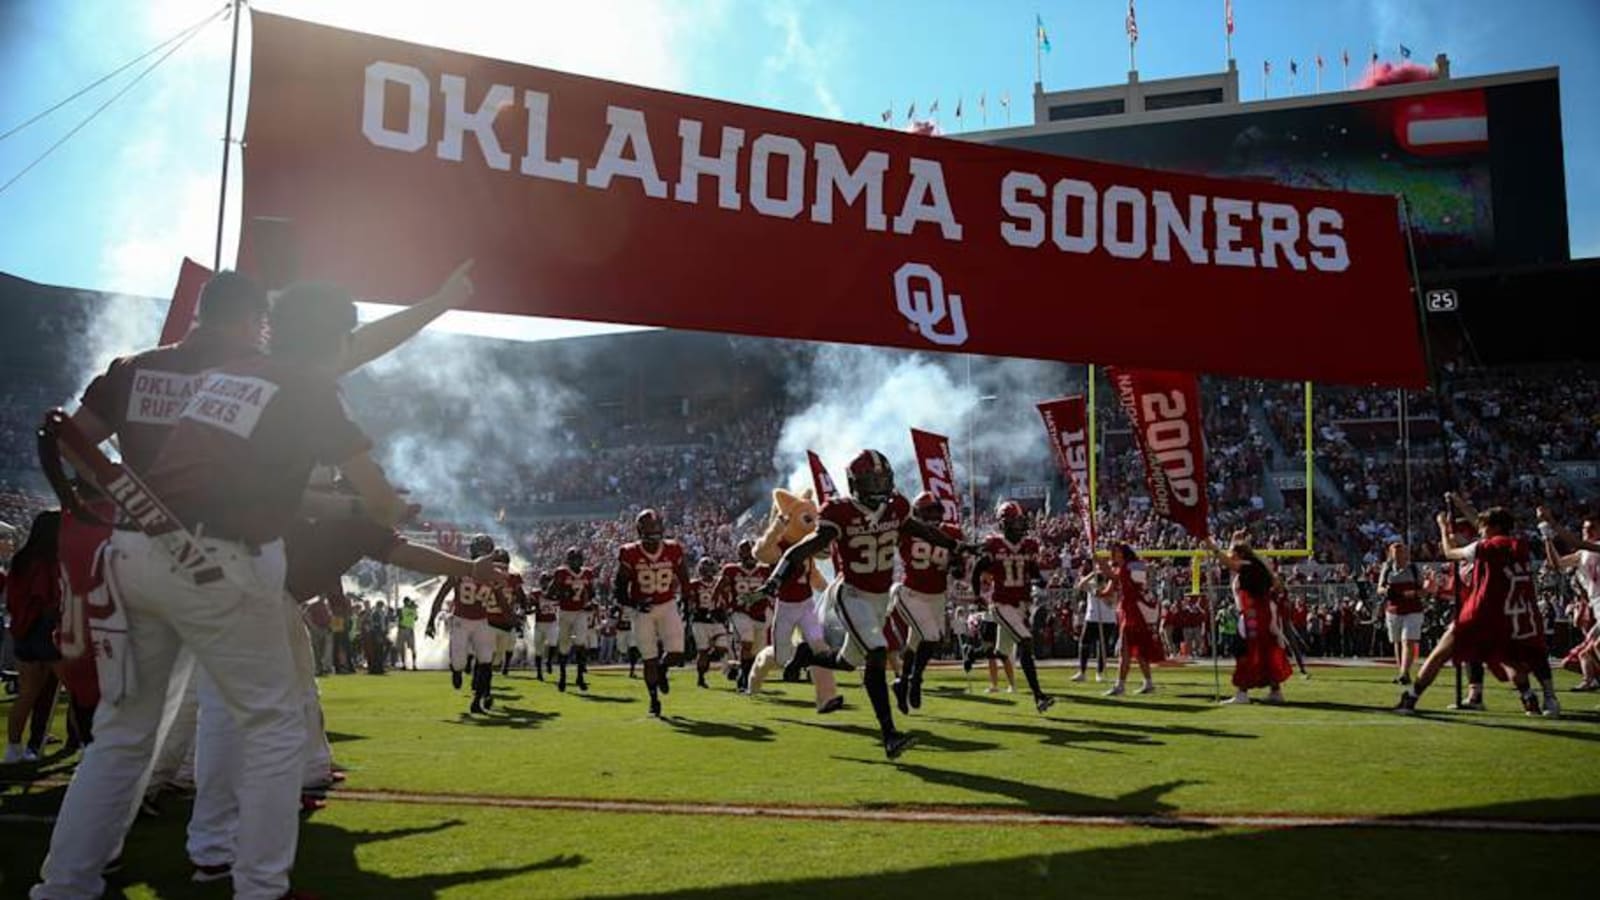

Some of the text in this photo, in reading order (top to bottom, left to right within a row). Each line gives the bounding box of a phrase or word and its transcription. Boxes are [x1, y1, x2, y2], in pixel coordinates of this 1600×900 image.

[362, 61, 1350, 272] OKLAHOMA SOONERS
[893, 262, 968, 345] OU
[1431, 293, 1453, 309] 25
[1141, 390, 1198, 507] 2000
[848, 530, 899, 574] 32
[910, 543, 949, 571] 94
[1002, 559, 1025, 588] 11
